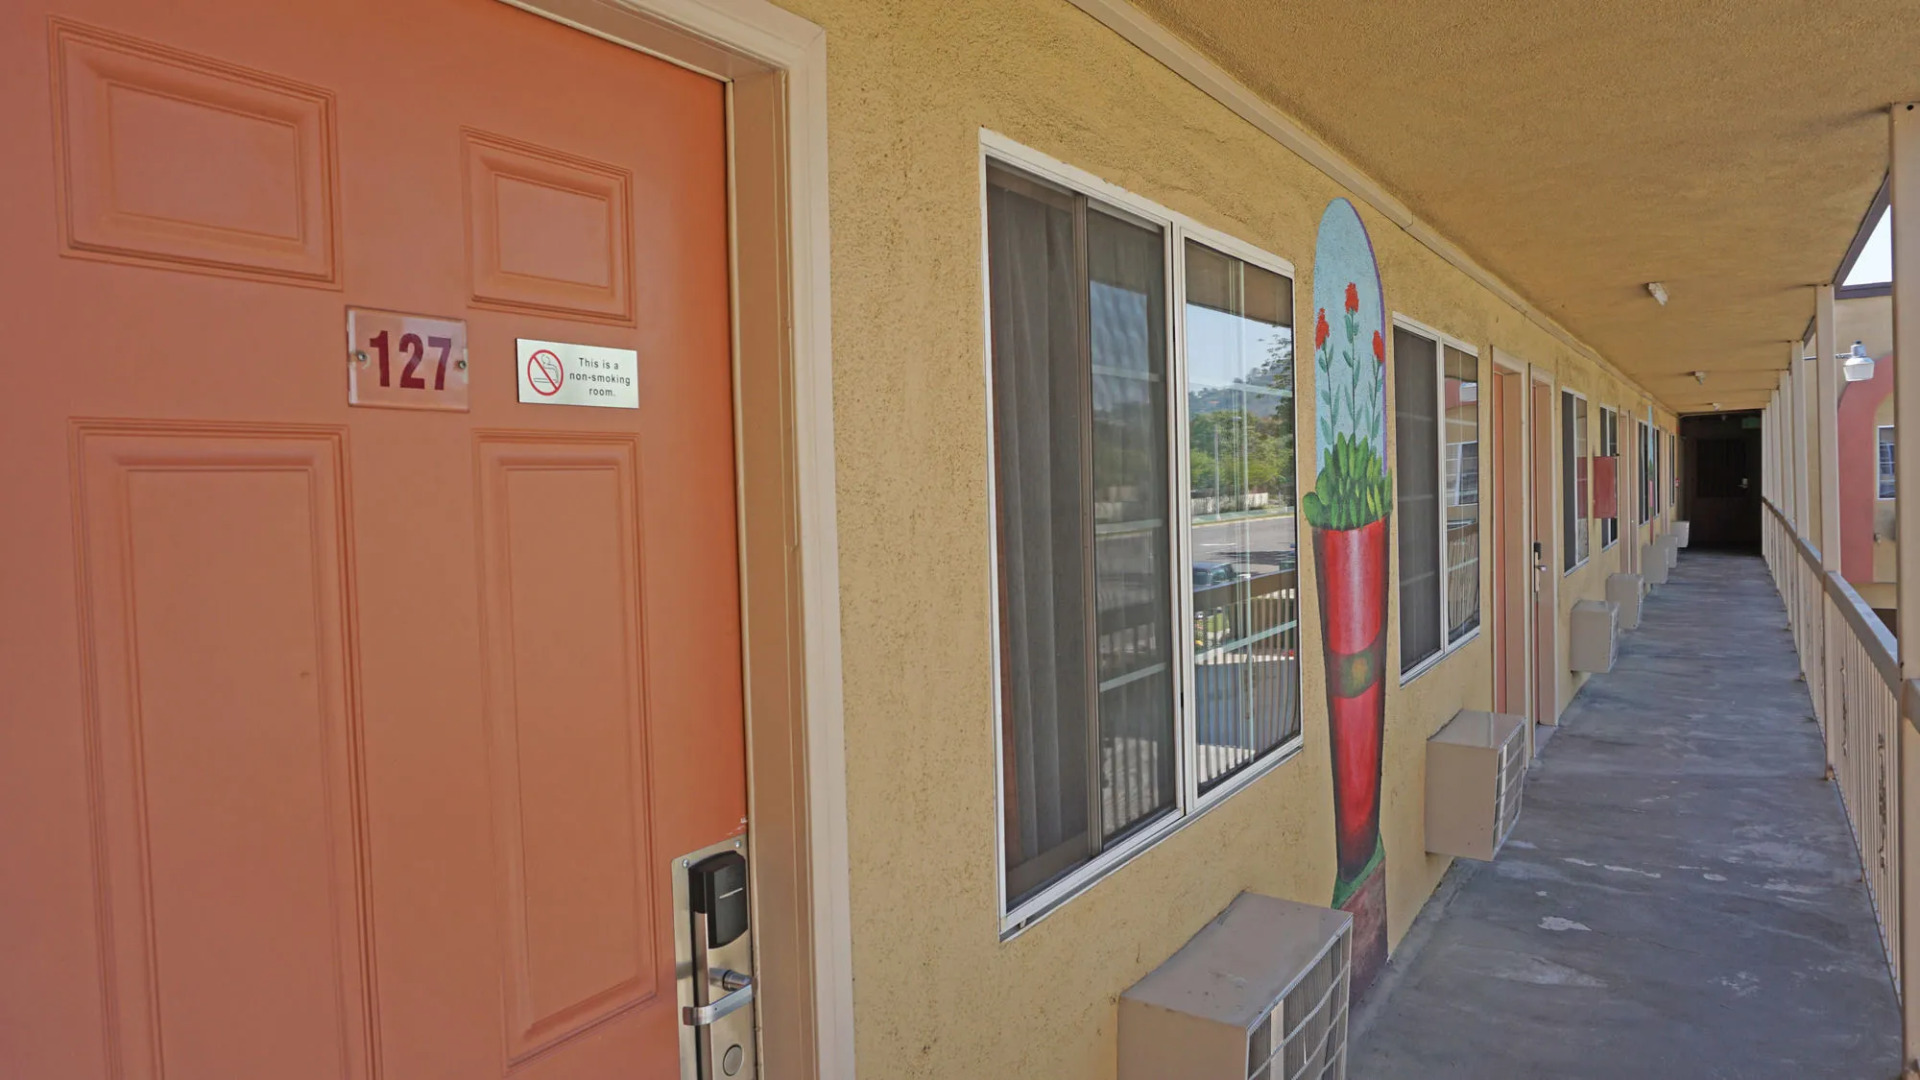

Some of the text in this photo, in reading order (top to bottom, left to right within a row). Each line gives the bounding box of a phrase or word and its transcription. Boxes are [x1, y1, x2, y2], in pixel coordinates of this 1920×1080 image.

[369, 330, 452, 390] 127
[579, 357, 619, 370] This is a
[569, 372, 631, 386] non-smoking
[589, 388, 616, 397] room.
